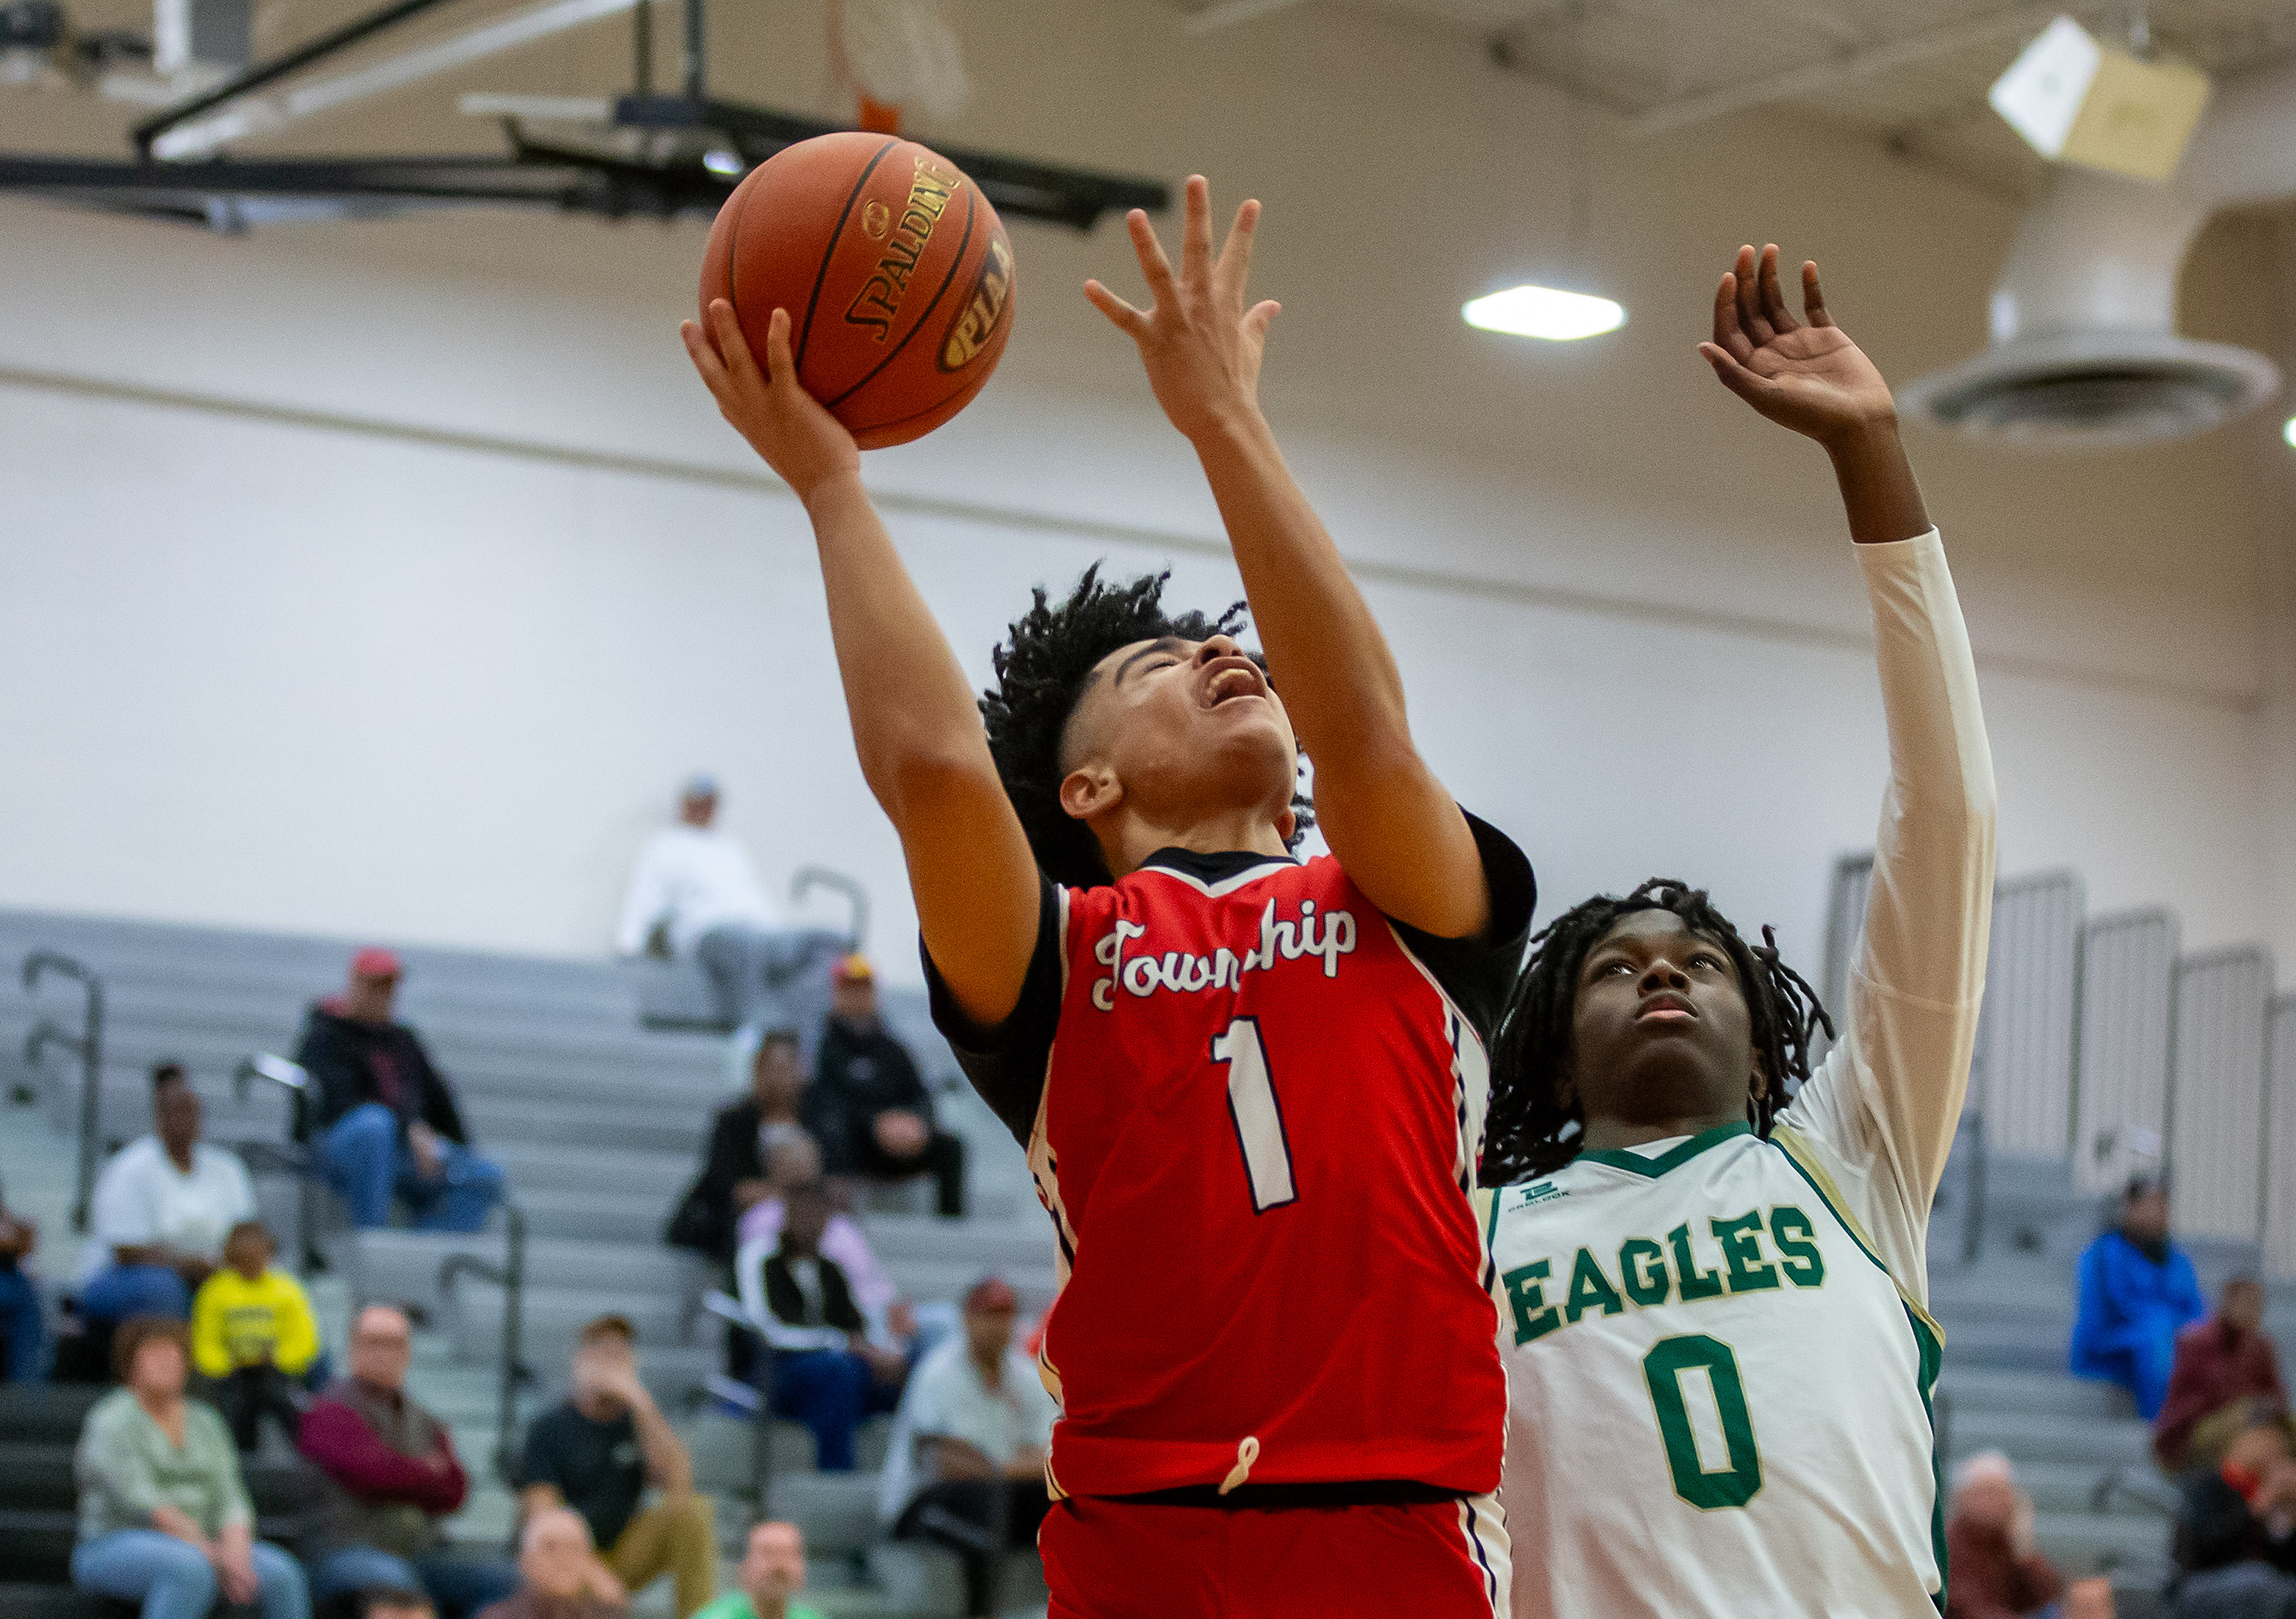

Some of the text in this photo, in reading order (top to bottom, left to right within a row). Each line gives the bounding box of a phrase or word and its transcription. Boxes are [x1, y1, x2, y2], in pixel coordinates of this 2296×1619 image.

[1092, 897, 1357, 1012] Townhip
[1210, 1015, 1299, 1215] 1
[1501, 1203, 1827, 1347] EAGLES
[1641, 1333, 1765, 1513] 0
